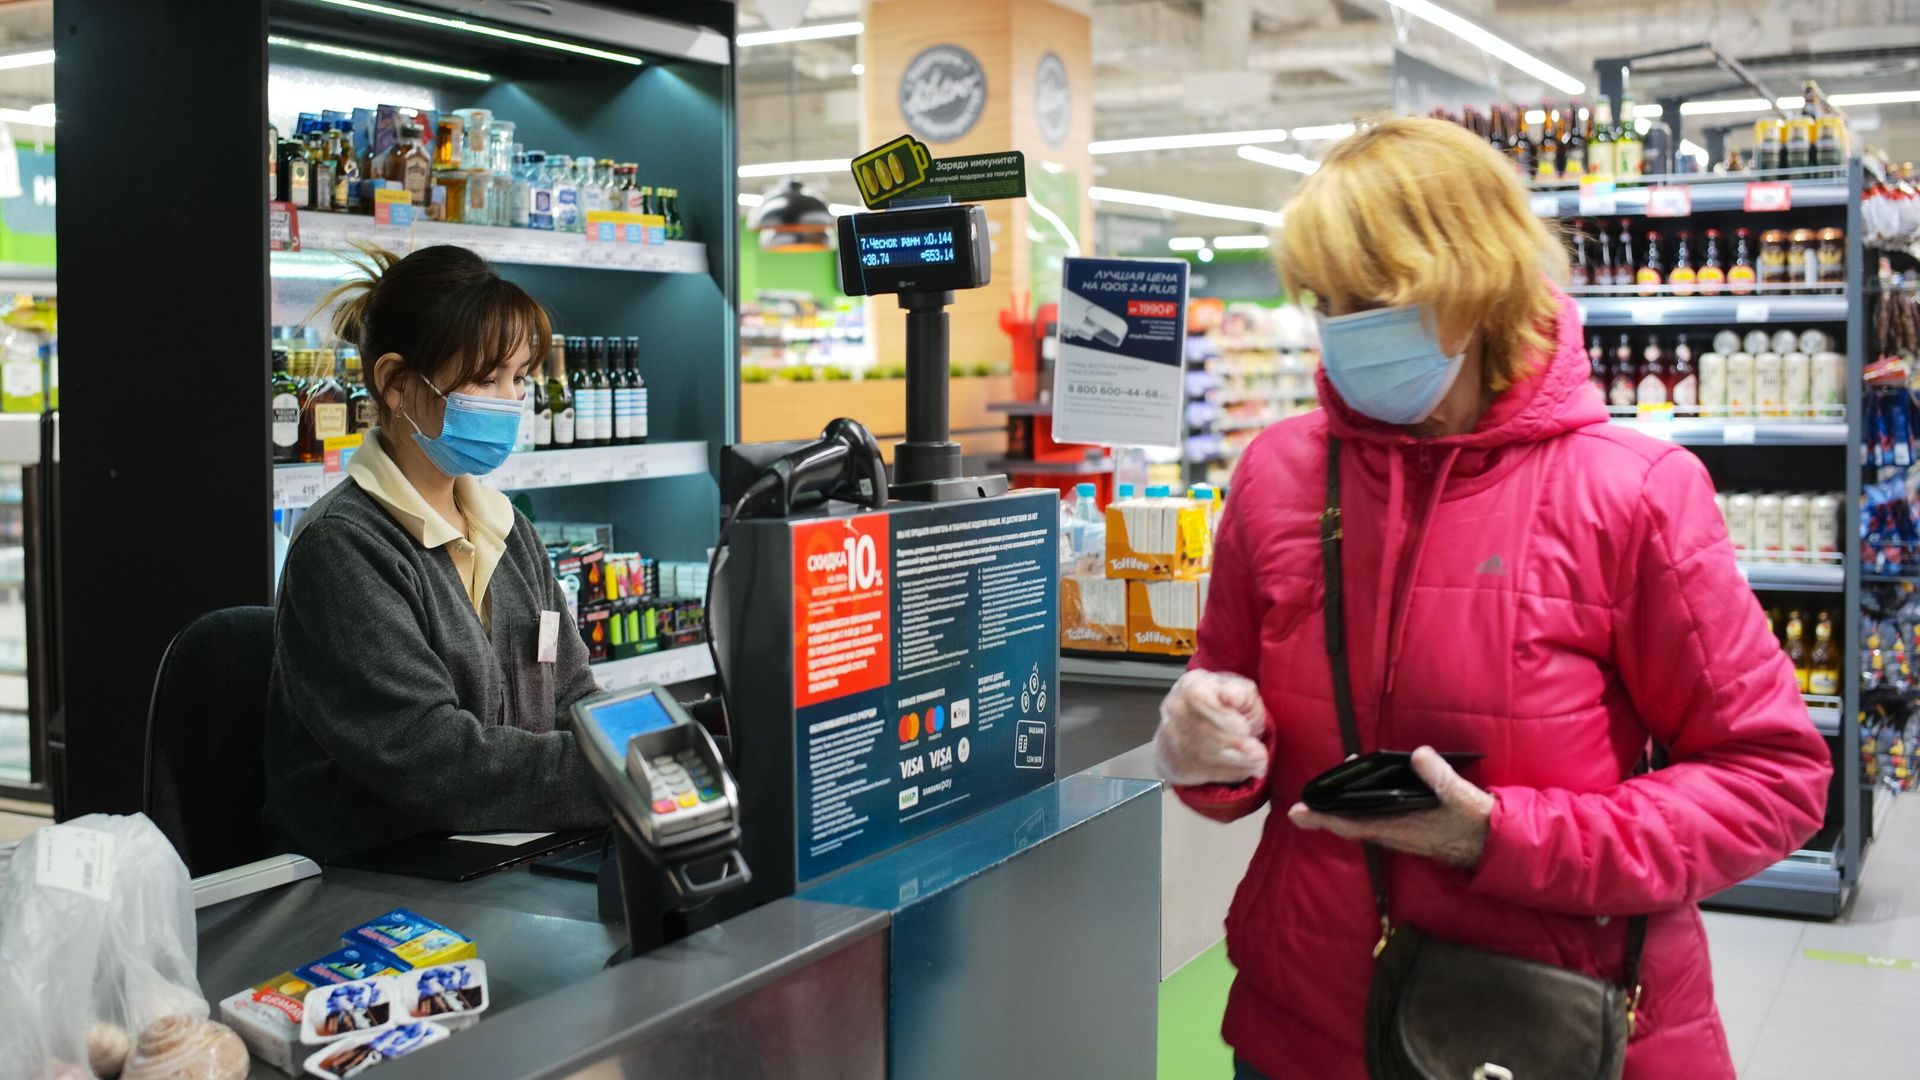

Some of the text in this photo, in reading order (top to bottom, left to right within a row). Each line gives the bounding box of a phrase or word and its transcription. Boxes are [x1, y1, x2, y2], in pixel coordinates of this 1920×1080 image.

[935, 155, 1018, 172] Заряди иммунитет
[934, 174, 959, 184] получай
[1094, 270, 1179, 284] ЛУЧШАЯ ЦЕНА
[1082, 281, 1178, 295] НА IQOS 2.4 PLUS
[1077, 385, 1097, 394] 800
[807, 550, 847, 573] СКИДКА
[843, 533, 877, 592] 10
[1110, 558, 1150, 571] Toffifee
[1135, 631, 1172, 645] Toffifee
[957, 708, 967, 719] Pay
[928, 745, 952, 769] VISA
[899, 755, 924, 780] VISA
